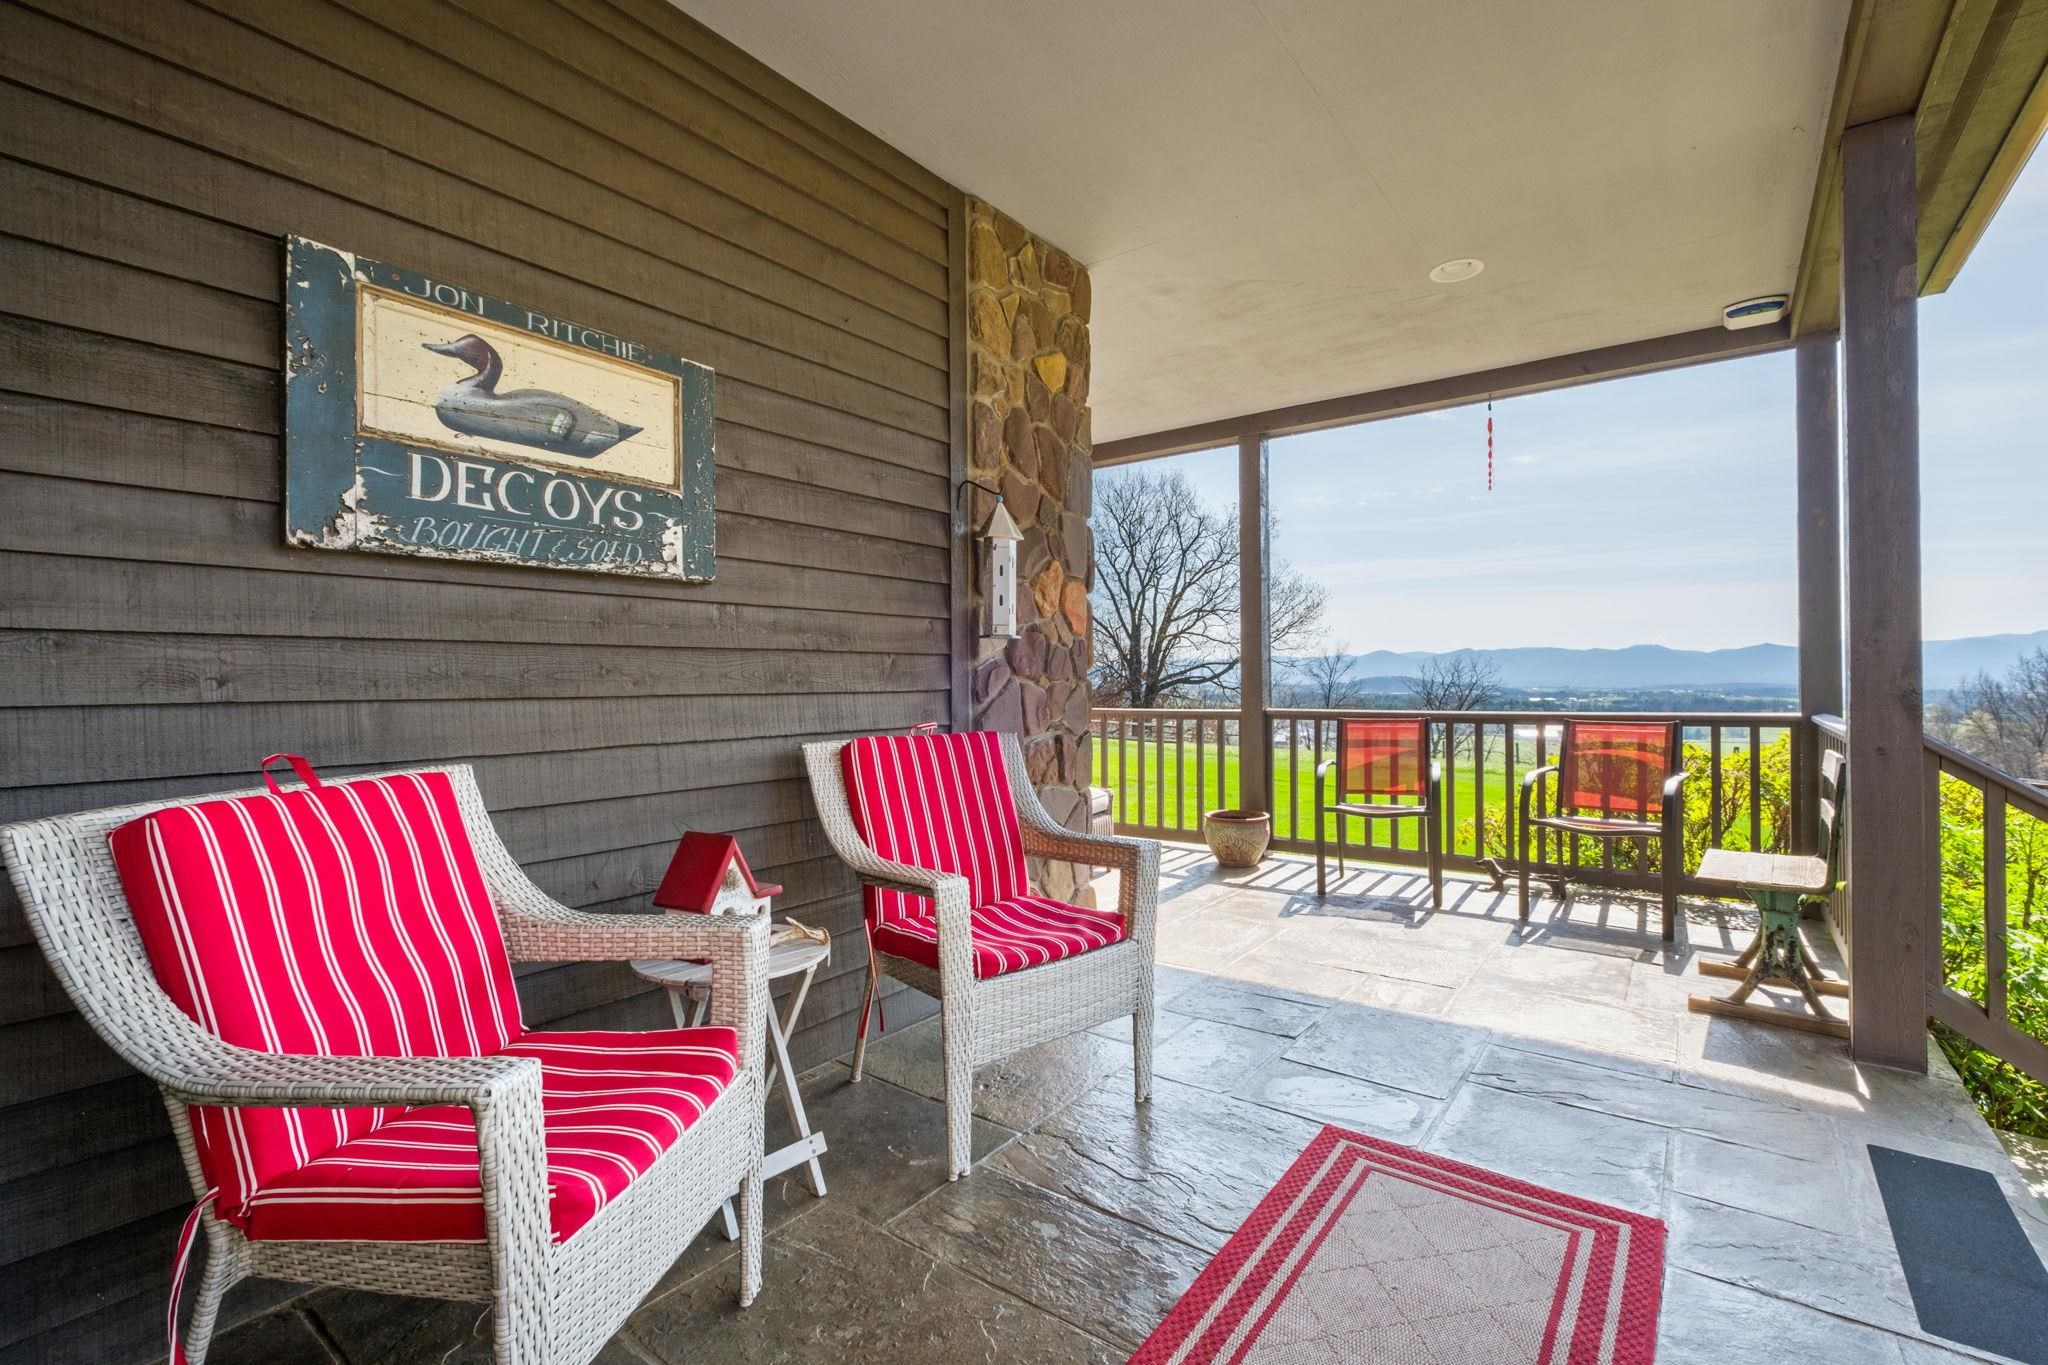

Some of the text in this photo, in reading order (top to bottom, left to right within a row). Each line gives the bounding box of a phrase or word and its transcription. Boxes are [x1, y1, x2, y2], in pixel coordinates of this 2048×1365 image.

[404, 278, 646, 364] JON RITCHIE
[407, 451, 644, 532] DECOYS
[409, 516, 560, 557] BOUGHT
[566, 536, 643, 566] SOLD
